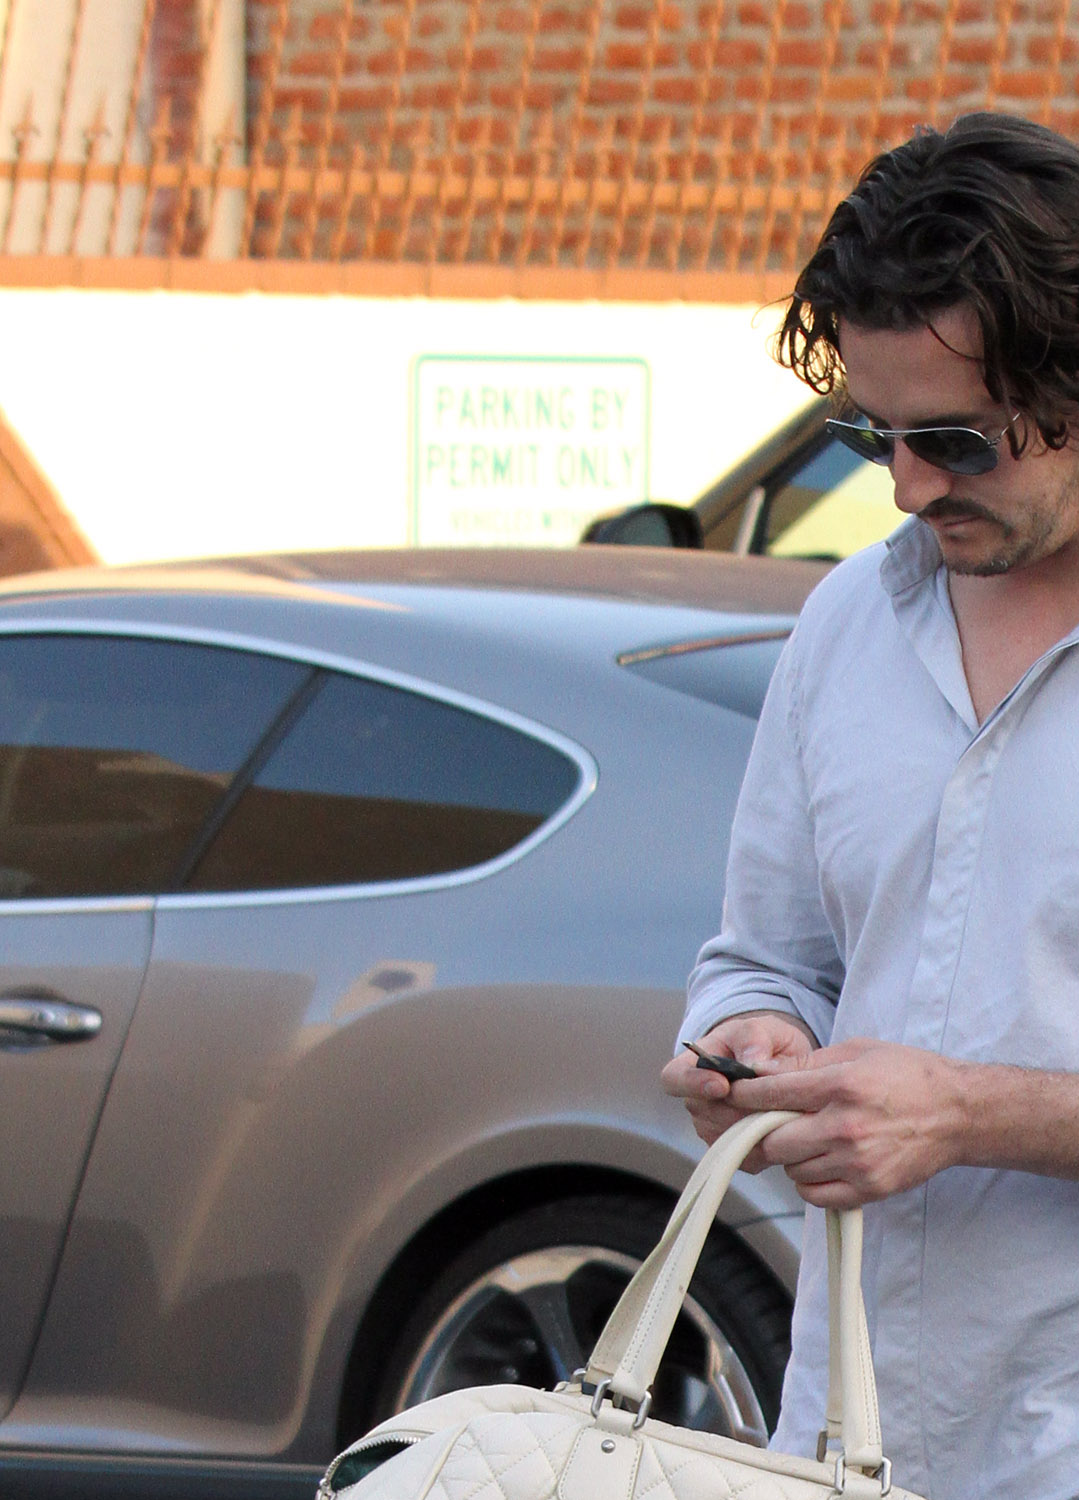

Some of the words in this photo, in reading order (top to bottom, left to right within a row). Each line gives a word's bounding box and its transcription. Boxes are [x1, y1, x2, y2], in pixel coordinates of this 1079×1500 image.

[435, 385, 575, 431] PARKING
[590, 387, 630, 432] BY
[425, 442, 541, 489] PERMIT
[557, 444, 639, 490] ONLY
